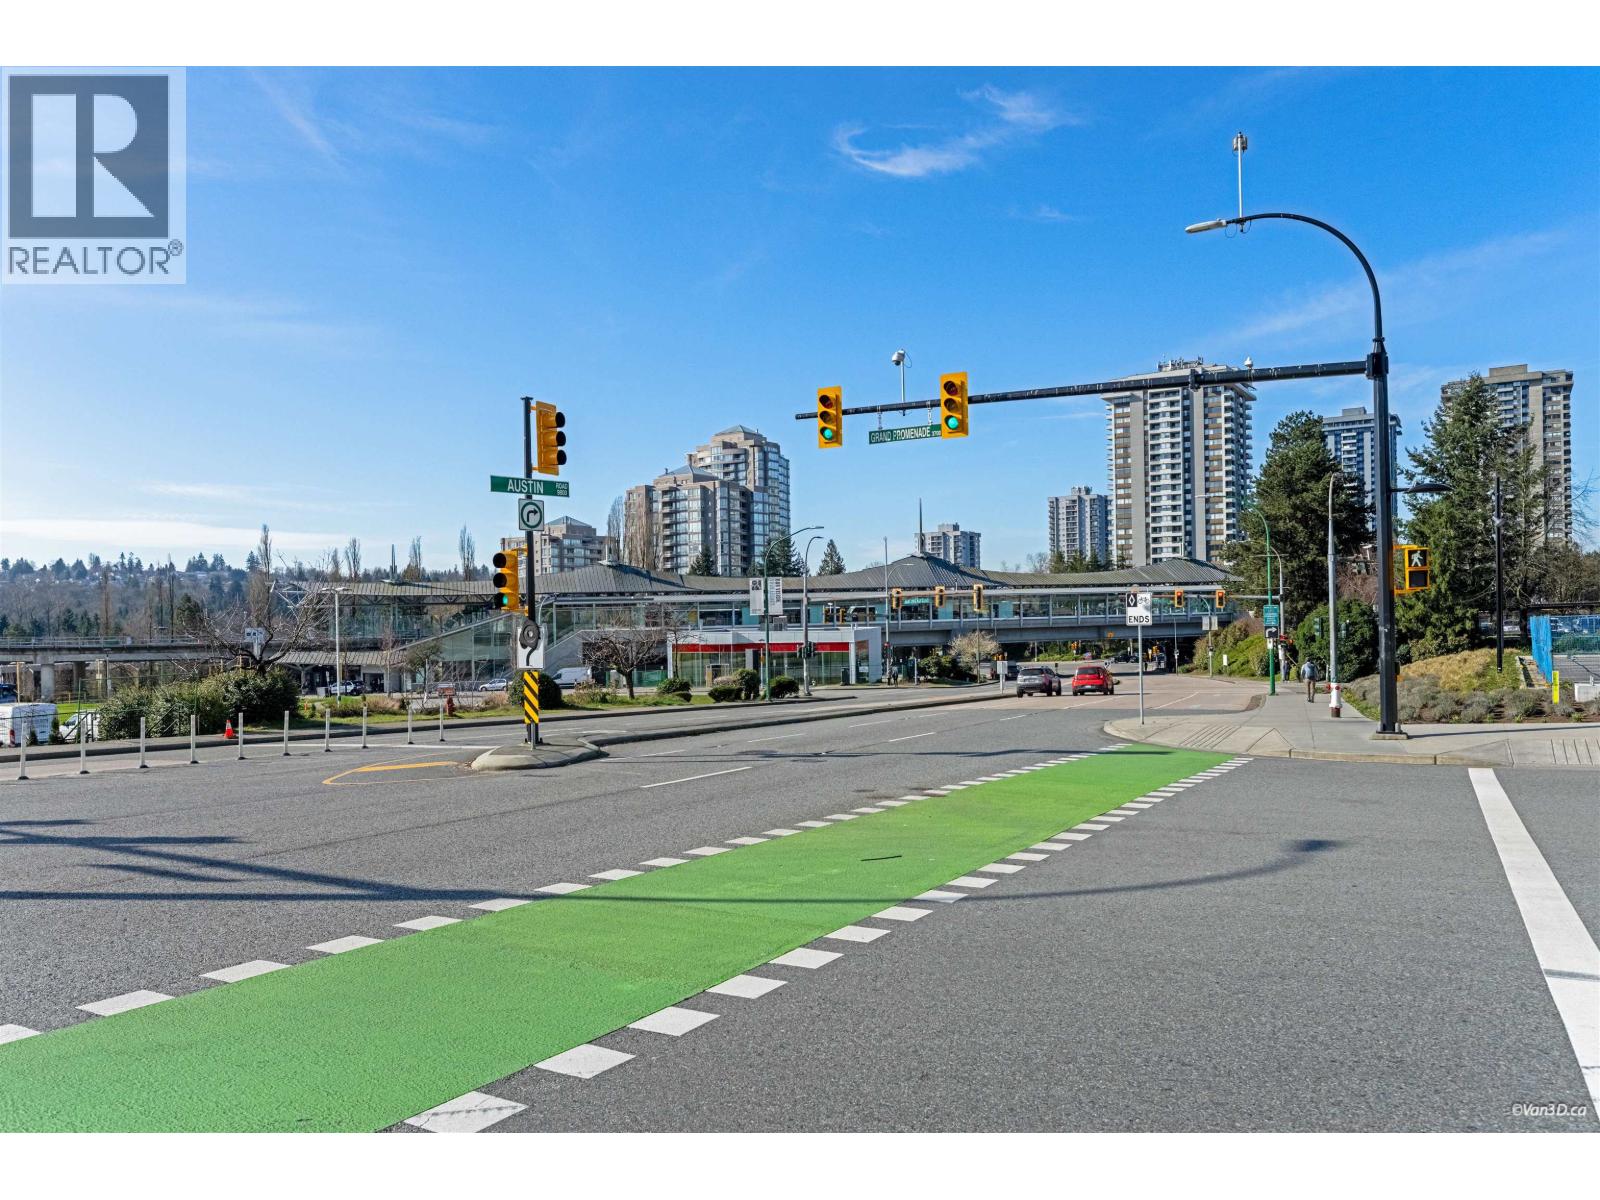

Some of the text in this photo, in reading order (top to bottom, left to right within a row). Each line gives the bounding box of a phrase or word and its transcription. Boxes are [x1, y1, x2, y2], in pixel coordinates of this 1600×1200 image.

[870, 431, 892, 443] GRAND
[892, 426, 931, 440] PROMENADE
[507, 479, 544, 494] AUSTIN
[555, 482, 568, 490] ROAD
[1128, 615, 1150, 624] ENDS
